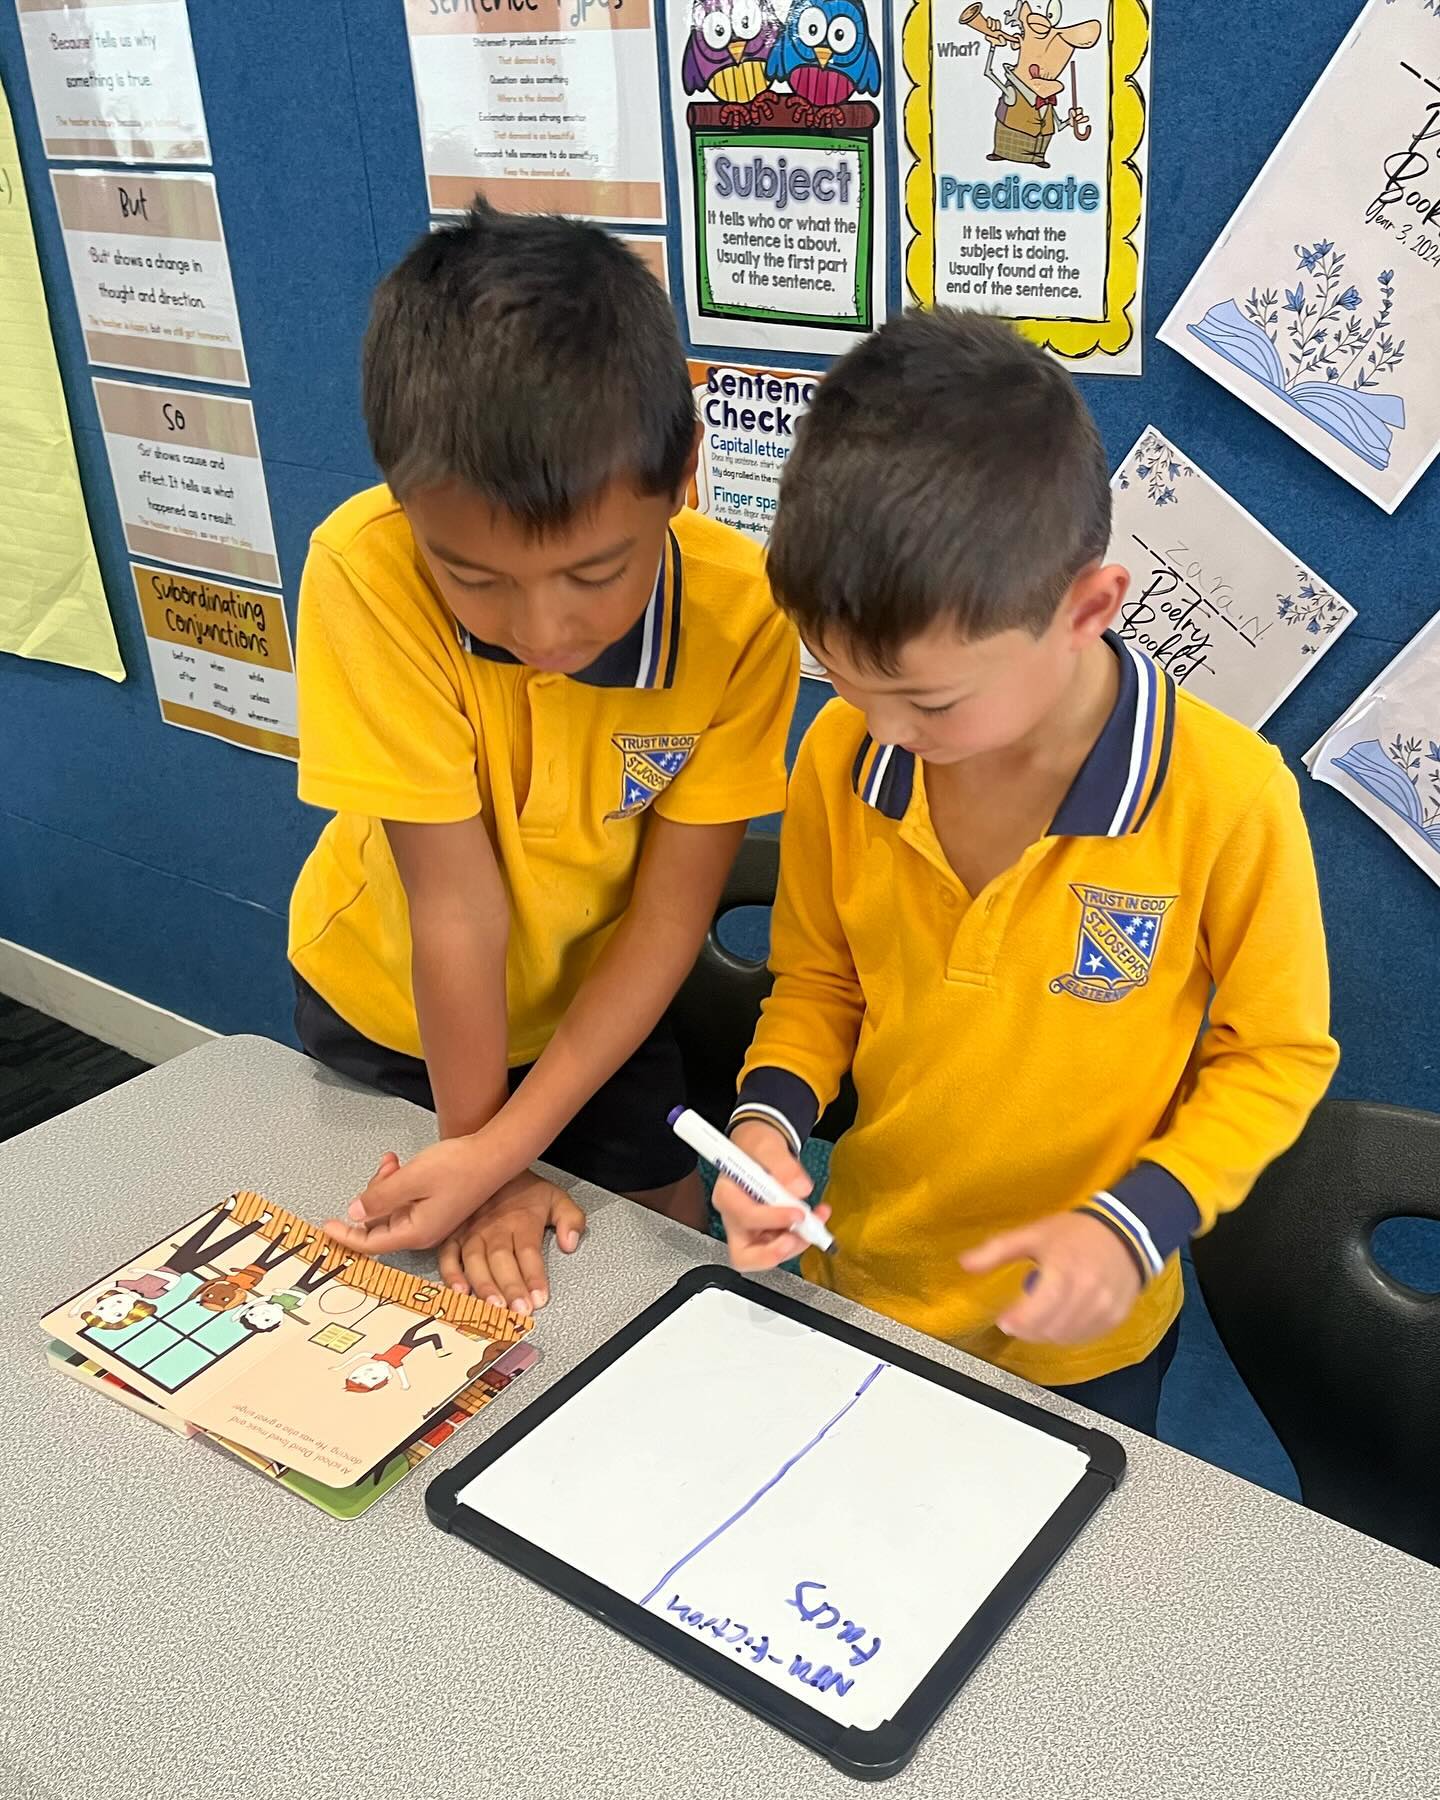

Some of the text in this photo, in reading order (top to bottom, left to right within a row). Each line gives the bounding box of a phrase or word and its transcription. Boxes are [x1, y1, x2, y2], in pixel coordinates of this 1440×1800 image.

[557, 0, 623, 27] ypes
[95, 30, 118, 48] tells
[120, 36, 132, 48] us
[134, 30, 157, 51] why
[472, 37, 507, 47] Statement
[509, 36, 537, 48] provides
[937, 40, 981, 58] What?
[65, 70, 115, 91] something
[115, 73, 126, 87] is
[489, 74, 569, 86] Question asks something
[478, 111, 516, 122] Exclamation
[517, 111, 538, 122] shows
[539, 112, 562, 124] strong
[474, 147, 503, 159] Command
[504, 148, 519, 159] tells
[520, 151, 548, 160] someone
[549, 148, 557, 160] to
[558, 148, 568, 160] do
[714, 156, 852, 209] Subject
[939, 175, 1100, 211] Predicate
[118, 187, 149, 221] But
[708, 210, 857, 234] It tells who or what the
[1365, 191, 1395, 231] Year
[1410, 234, 1440, 268] 2024
[722, 232, 841, 253] sentence is about.
[962, 226, 1066, 242] It tells what the
[114, 249, 143, 267] shows
[145, 257, 154, 269] a
[155, 252, 190, 275] change
[191, 259, 203, 273] in
[717, 249, 848, 274] Usually the first part
[960, 244, 1069, 263] subject is doing.
[732, 270, 836, 292] of the sentence.
[949, 262, 1080, 280] Usually found at the
[98, 281, 206, 309] thought and direction.
[946, 279, 1082, 300] end of the sentence.
[163, 403, 186, 431] So
[711, 433, 790, 459] Capital letter
[154, 446, 181, 463] shows
[182, 454, 208, 467] cause
[209, 457, 225, 470] and
[712, 466, 723, 478] My
[723, 468, 735, 480] dog
[735, 470, 754, 481] rolled
[754, 471, 761, 482] in
[761, 473, 772, 483] the
[168, 474, 179, 489] It
[180, 477, 200, 493] tells
[201, 485, 212, 495] us
[213, 483, 235, 500] what
[713, 485, 753, 509] Finger
[147, 496, 186, 518] happened
[187, 509, 199, 520] as
[200, 511, 208, 521] a
[151, 575, 267, 632] Subordinating
[1140, 568, 1214, 648] Poetry
[165, 607, 270, 658] Conjunctions
[1118, 602, 1215, 685] Booklet
[172, 649, 196, 665] before
[620, 736, 695, 750] TRUST IN GOD
[1084, 888, 1167, 912] TRUST IN GOD
[227, 1415, 248, 1426] and
[265, 1432, 290, 1448] loved
[298, 1433, 314, 1443] was
[314, 1440, 328, 1451] He
[313, 1455, 341, 1469] school
